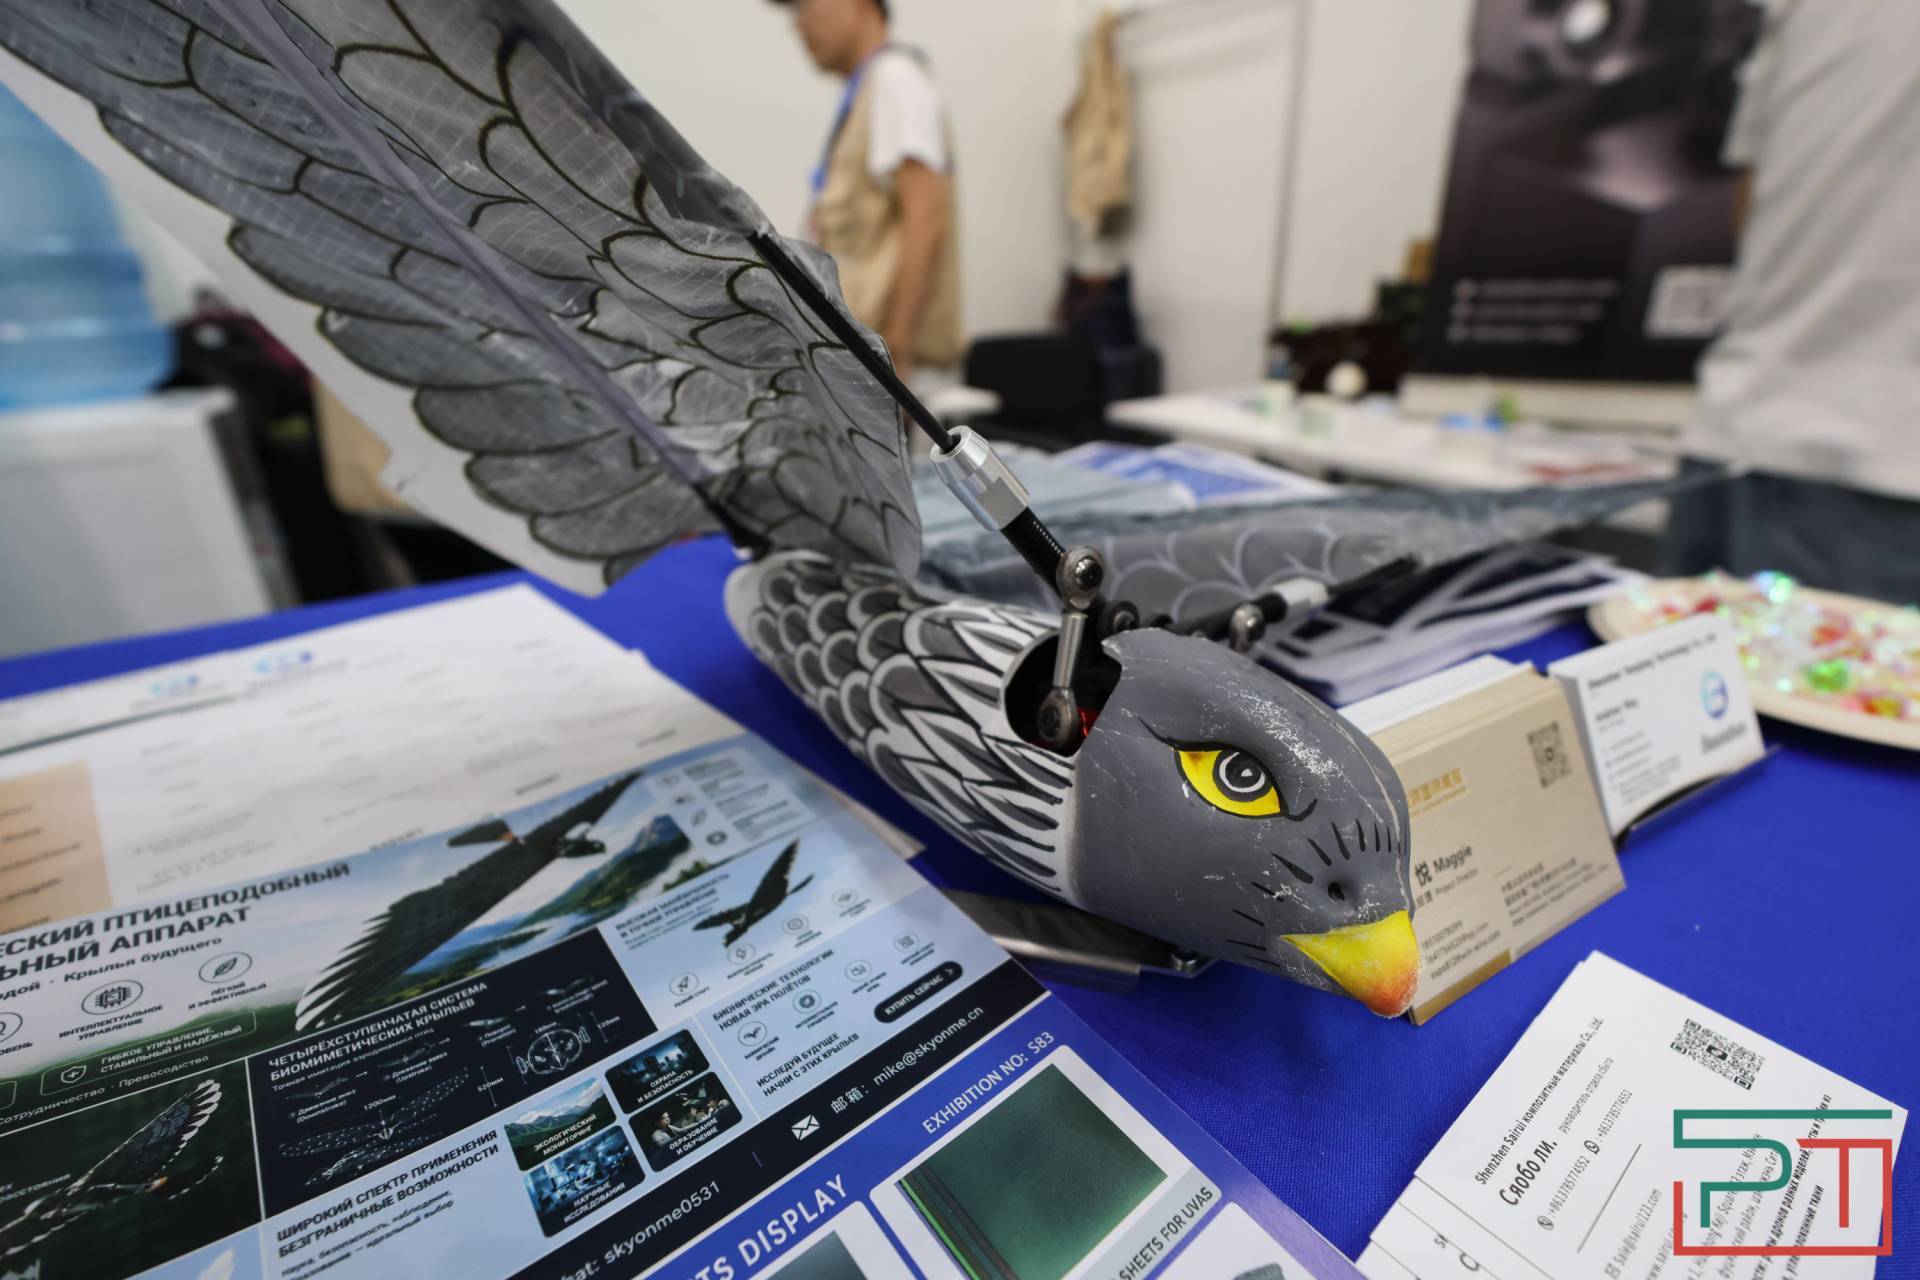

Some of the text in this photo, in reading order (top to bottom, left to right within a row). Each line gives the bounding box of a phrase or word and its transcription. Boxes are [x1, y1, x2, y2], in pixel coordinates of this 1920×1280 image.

[1433, 845, 1472, 874] Maggie
[103, 863, 350, 932] ПТИЦЕПОДОБНЫЙ
[109, 906, 250, 953] АППАРАТ
[64, 959, 136, 982] Крылья
[141, 938, 222, 961] будущего
[712, 981, 779, 1022] БИОНИЧЕСКИЕ
[779, 949, 835, 984] ТЕХНОЛОГИИ
[718, 975, 812, 1031] НОВАЯ ЭРА ПОЛЁТОВ
[884, 993, 916, 1016] КУПИТЬ
[914, 974, 944, 997] СЕЙЧАС
[59, 1005, 162, 1038] ИНТЕЛЛЕКТУАЛЬНОЕ
[79, 1018, 143, 1040] УПРАВЛЕНИЕ
[269, 982, 488, 1068] ЧЕТЫРЁХСТУПЕНЧАТАЯ СИСТЕМА
[270, 999, 476, 1082] БИОМИМЕТИЧЕСКИХ КРЫЛЬЕВ
[101, 1025, 242, 1073] СТАБИЛЬНЫЙ И НАДЁЖНЫЙ
[102, 1047, 140, 1065] ГИБКОЕ
[756, 1031, 840, 1088] ИССЛЕДУЙ БУДУЩЕЕ
[763, 1032, 860, 1098] НАЧНИ С ЭТИХ КРЫЛЬЕВ
[872, 1006, 984, 1087] mike@skyonme.cn
[272, 1076, 306, 1092] Точная
[364, 1094, 396, 1111] 1200мм
[643, 1067, 694, 1101] БЕЗОПАСНОСТЬ
[649, 1070, 677, 1089] ОХРАНА
[922, 1030, 1055, 1135] EXHIBITION NO: S83
[0, 1087, 105, 1125] Сотрудничество
[1474, 1138, 1510, 1186] Shenzhen
[1502, 1117, 1528, 1149] Sairui
[1521, 1072, 1563, 1124] композитные
[1557, 1037, 1590, 1081] материалы
[534, 1113, 597, 1153] ЭКОЛОГИЧЕСКИЙ
[543, 1124, 593, 1156] МОНИТОРИНГ
[668, 1116, 718, 1150] ОБРАЗОВАНИЕ
[683, 1126, 719, 1152] ОБУЧЕНИЕ
[1498, 1158, 1543, 1208] Сяобо
[1537, 1137, 1559, 1166] ли.
[1558, 1085, 1594, 1135] руководитель
[277, 1129, 498, 1242] ШИРОКИЙ СПЕКТР ПРИМЕНЕНИЯ
[278, 1144, 499, 1258] БЕЗГРАНИЧНЫЕ ВОЗМОЖНОСТИ
[563, 1182, 626, 1224] ИССЛЕДОВАНИЯ
[573, 1181, 612, 1208] НАУЧНЫЕ
[1769, 1206, 1787, 1240] дронов
[1780, 1177, 1799, 1211] разных
[1794, 1148, 1812, 1181] моделей,
[1810, 1184, 1825, 1208] ткани
[604, 1181, 720, 1265] skyonme0531
[737, 1174, 848, 1268] DISPLAY
[1119, 1185, 1214, 1280] SHEETS FOR UVAS
